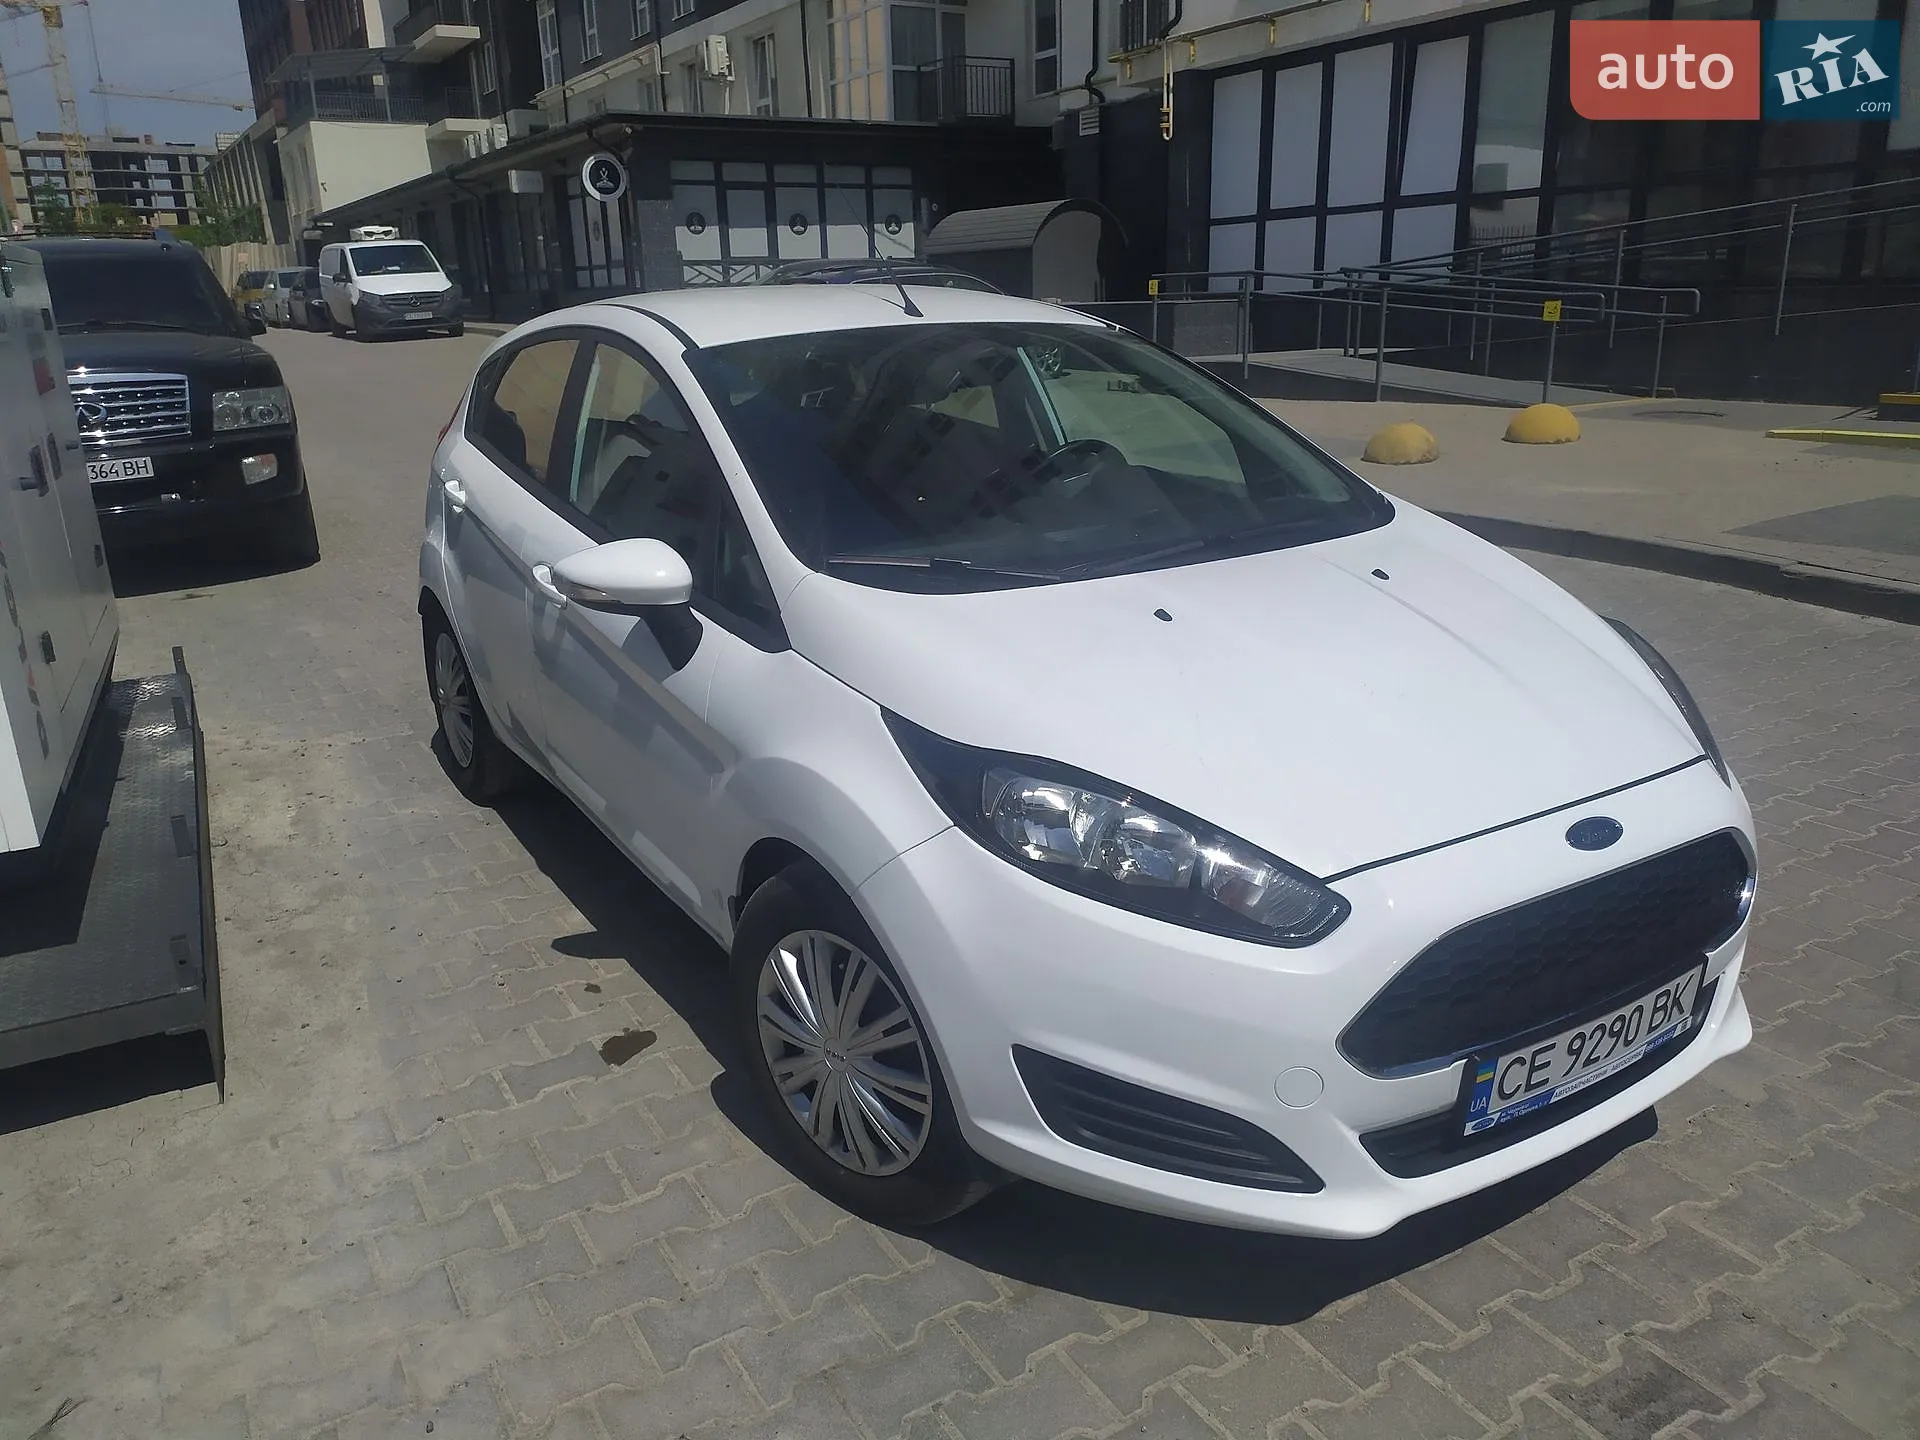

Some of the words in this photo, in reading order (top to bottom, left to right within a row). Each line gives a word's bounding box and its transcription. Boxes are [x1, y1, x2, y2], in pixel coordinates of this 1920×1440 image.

[122, 460, 149, 476] BH
[1498, 1042, 1557, 1101] CE
[1561, 1003, 1644, 1078] 9290
[1646, 972, 1696, 1037] BK
[1470, 1096, 1487, 1113] UA
